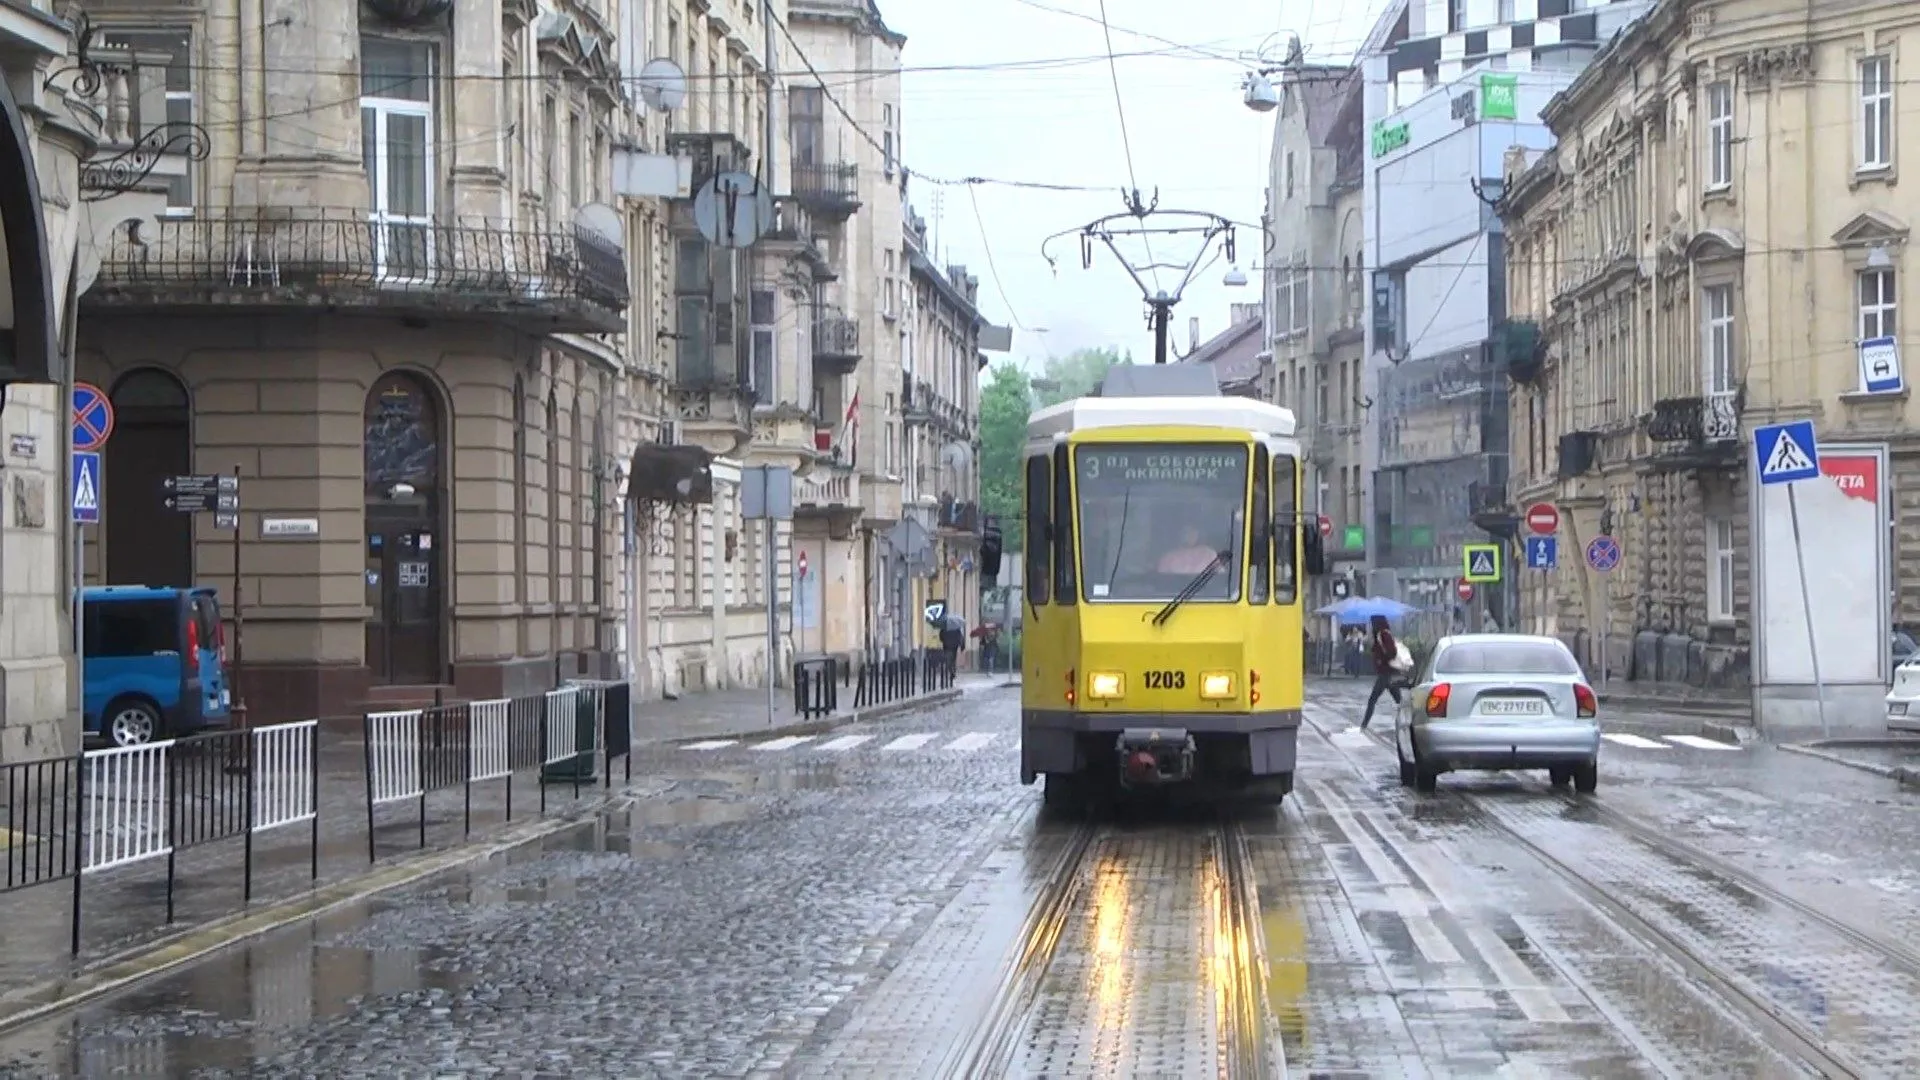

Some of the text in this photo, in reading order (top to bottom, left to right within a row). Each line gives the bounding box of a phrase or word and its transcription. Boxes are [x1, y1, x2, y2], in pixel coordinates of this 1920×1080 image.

[1085, 456, 1100, 479] 3
[1146, 455, 1236, 467] СОБОРНА
[1143, 671, 1185, 689] 1203
